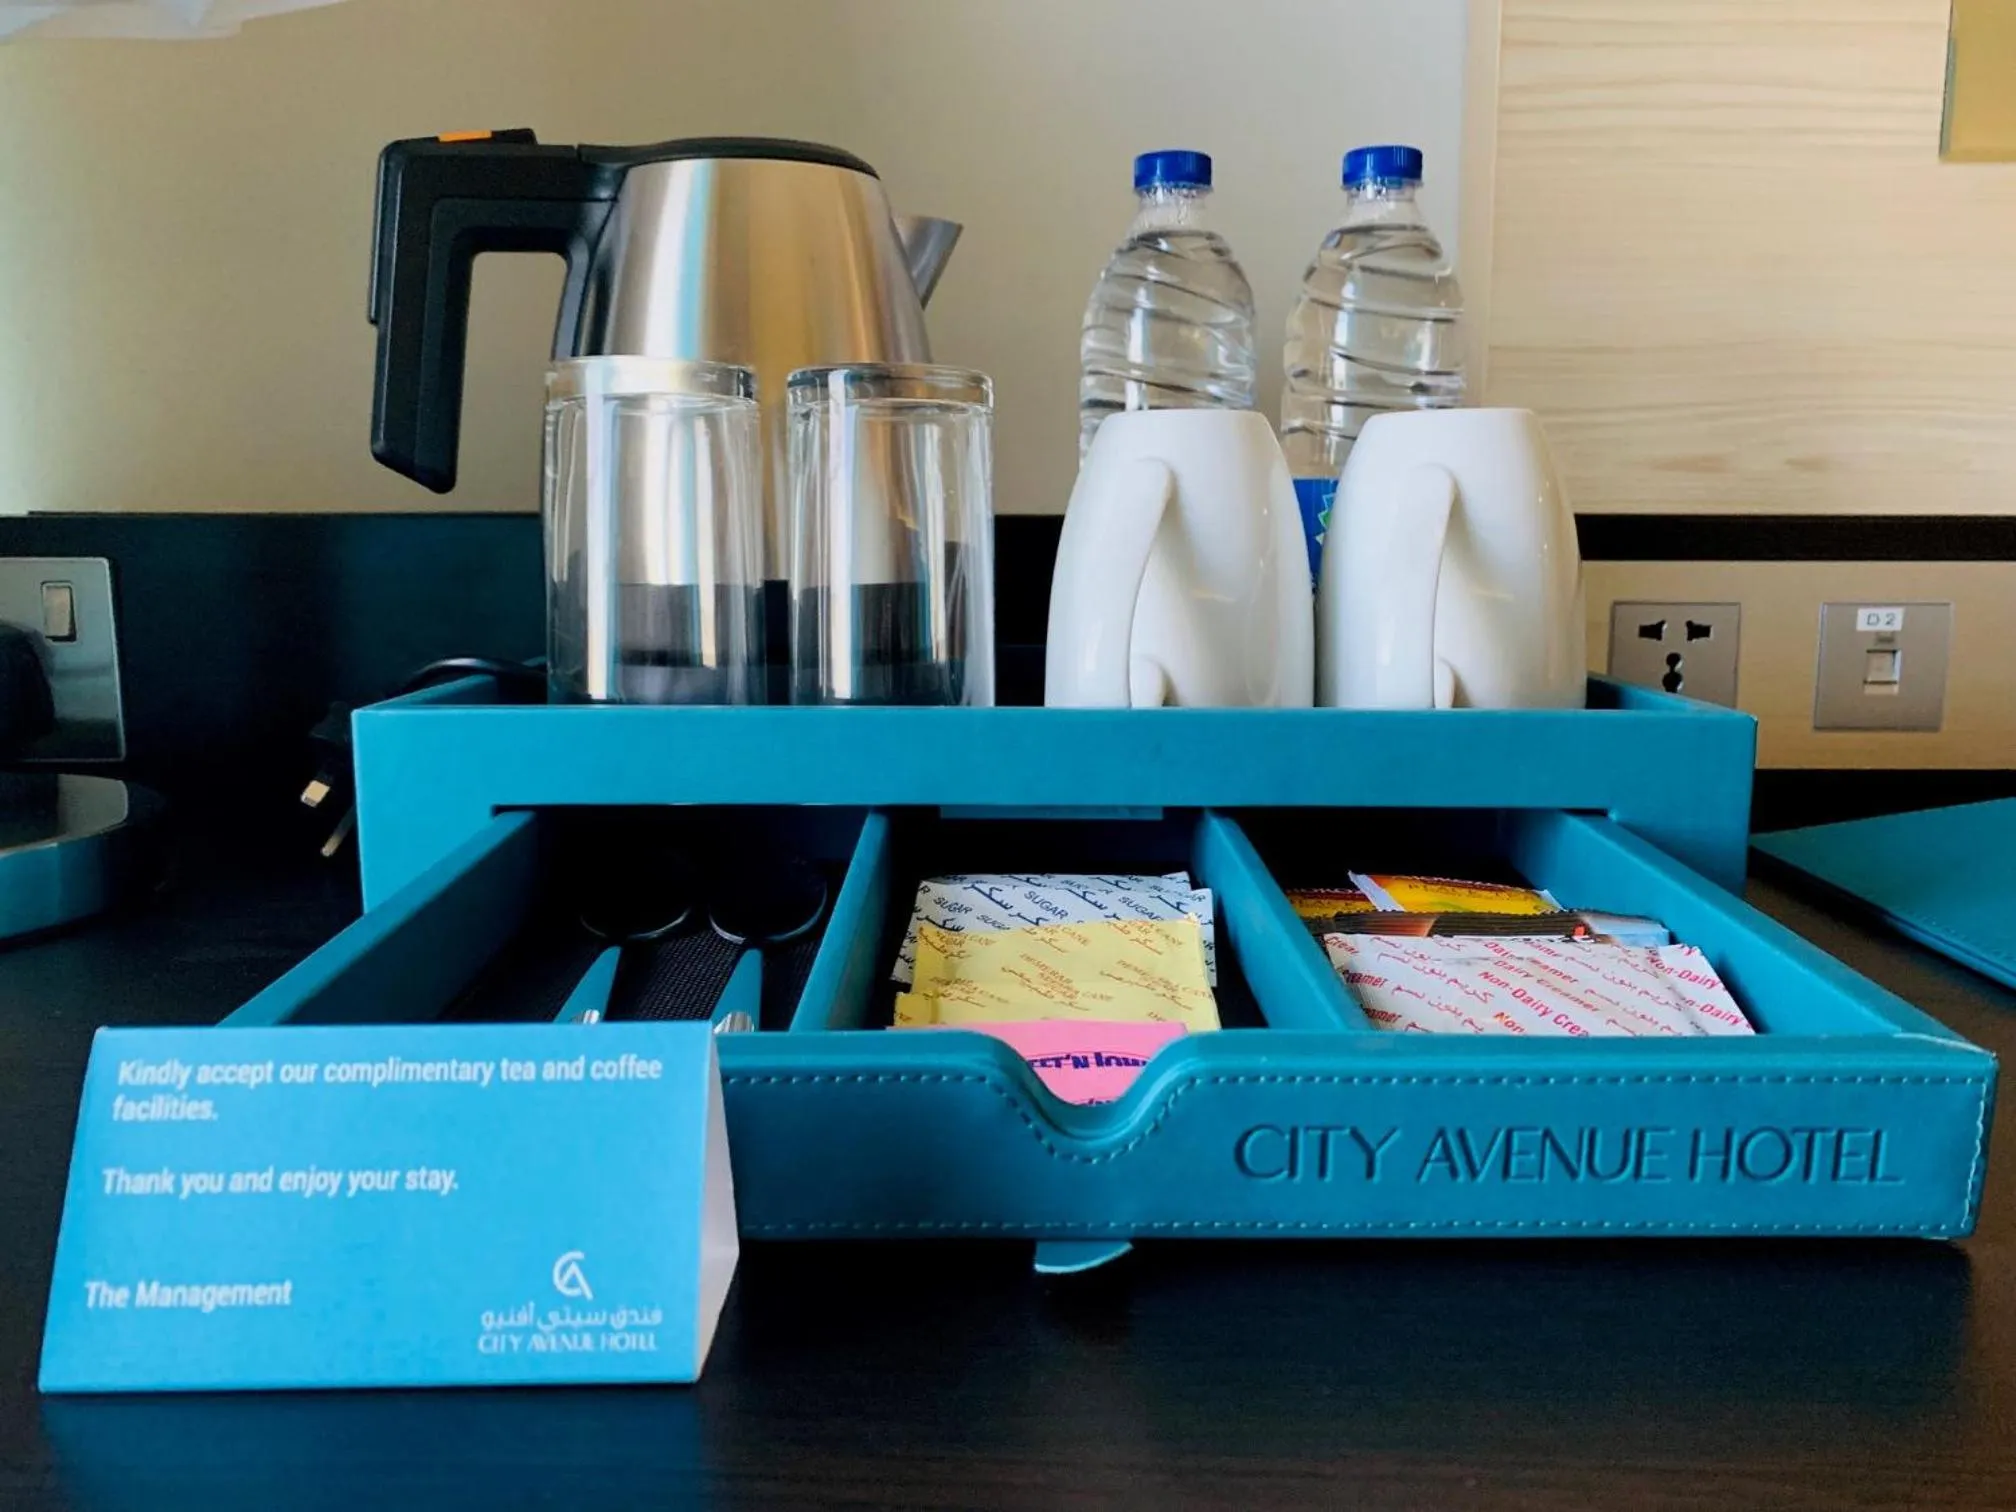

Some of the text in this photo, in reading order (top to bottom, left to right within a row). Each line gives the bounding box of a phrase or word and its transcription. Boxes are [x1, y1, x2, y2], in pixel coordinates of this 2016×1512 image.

[933, 897, 974, 915] SUGAR
[1024, 890, 1069, 917] SUGAR
[1478, 971, 1554, 1018] Non-Dairy
[1552, 1012, 1592, 1038] Crea
[118, 1053, 664, 1090] Kindly accept our complimentary tea and coffee
[111, 1093, 219, 1122] facilities.
[1232, 1124, 1906, 1187] CITY AVENUE HOTEL
[101, 1164, 460, 1200] Thank you and enjoy your stay.
[84, 1278, 293, 1314] The Management
[610, 1303, 664, 1331] فندق
[478, 1332, 524, 1355] CITY
